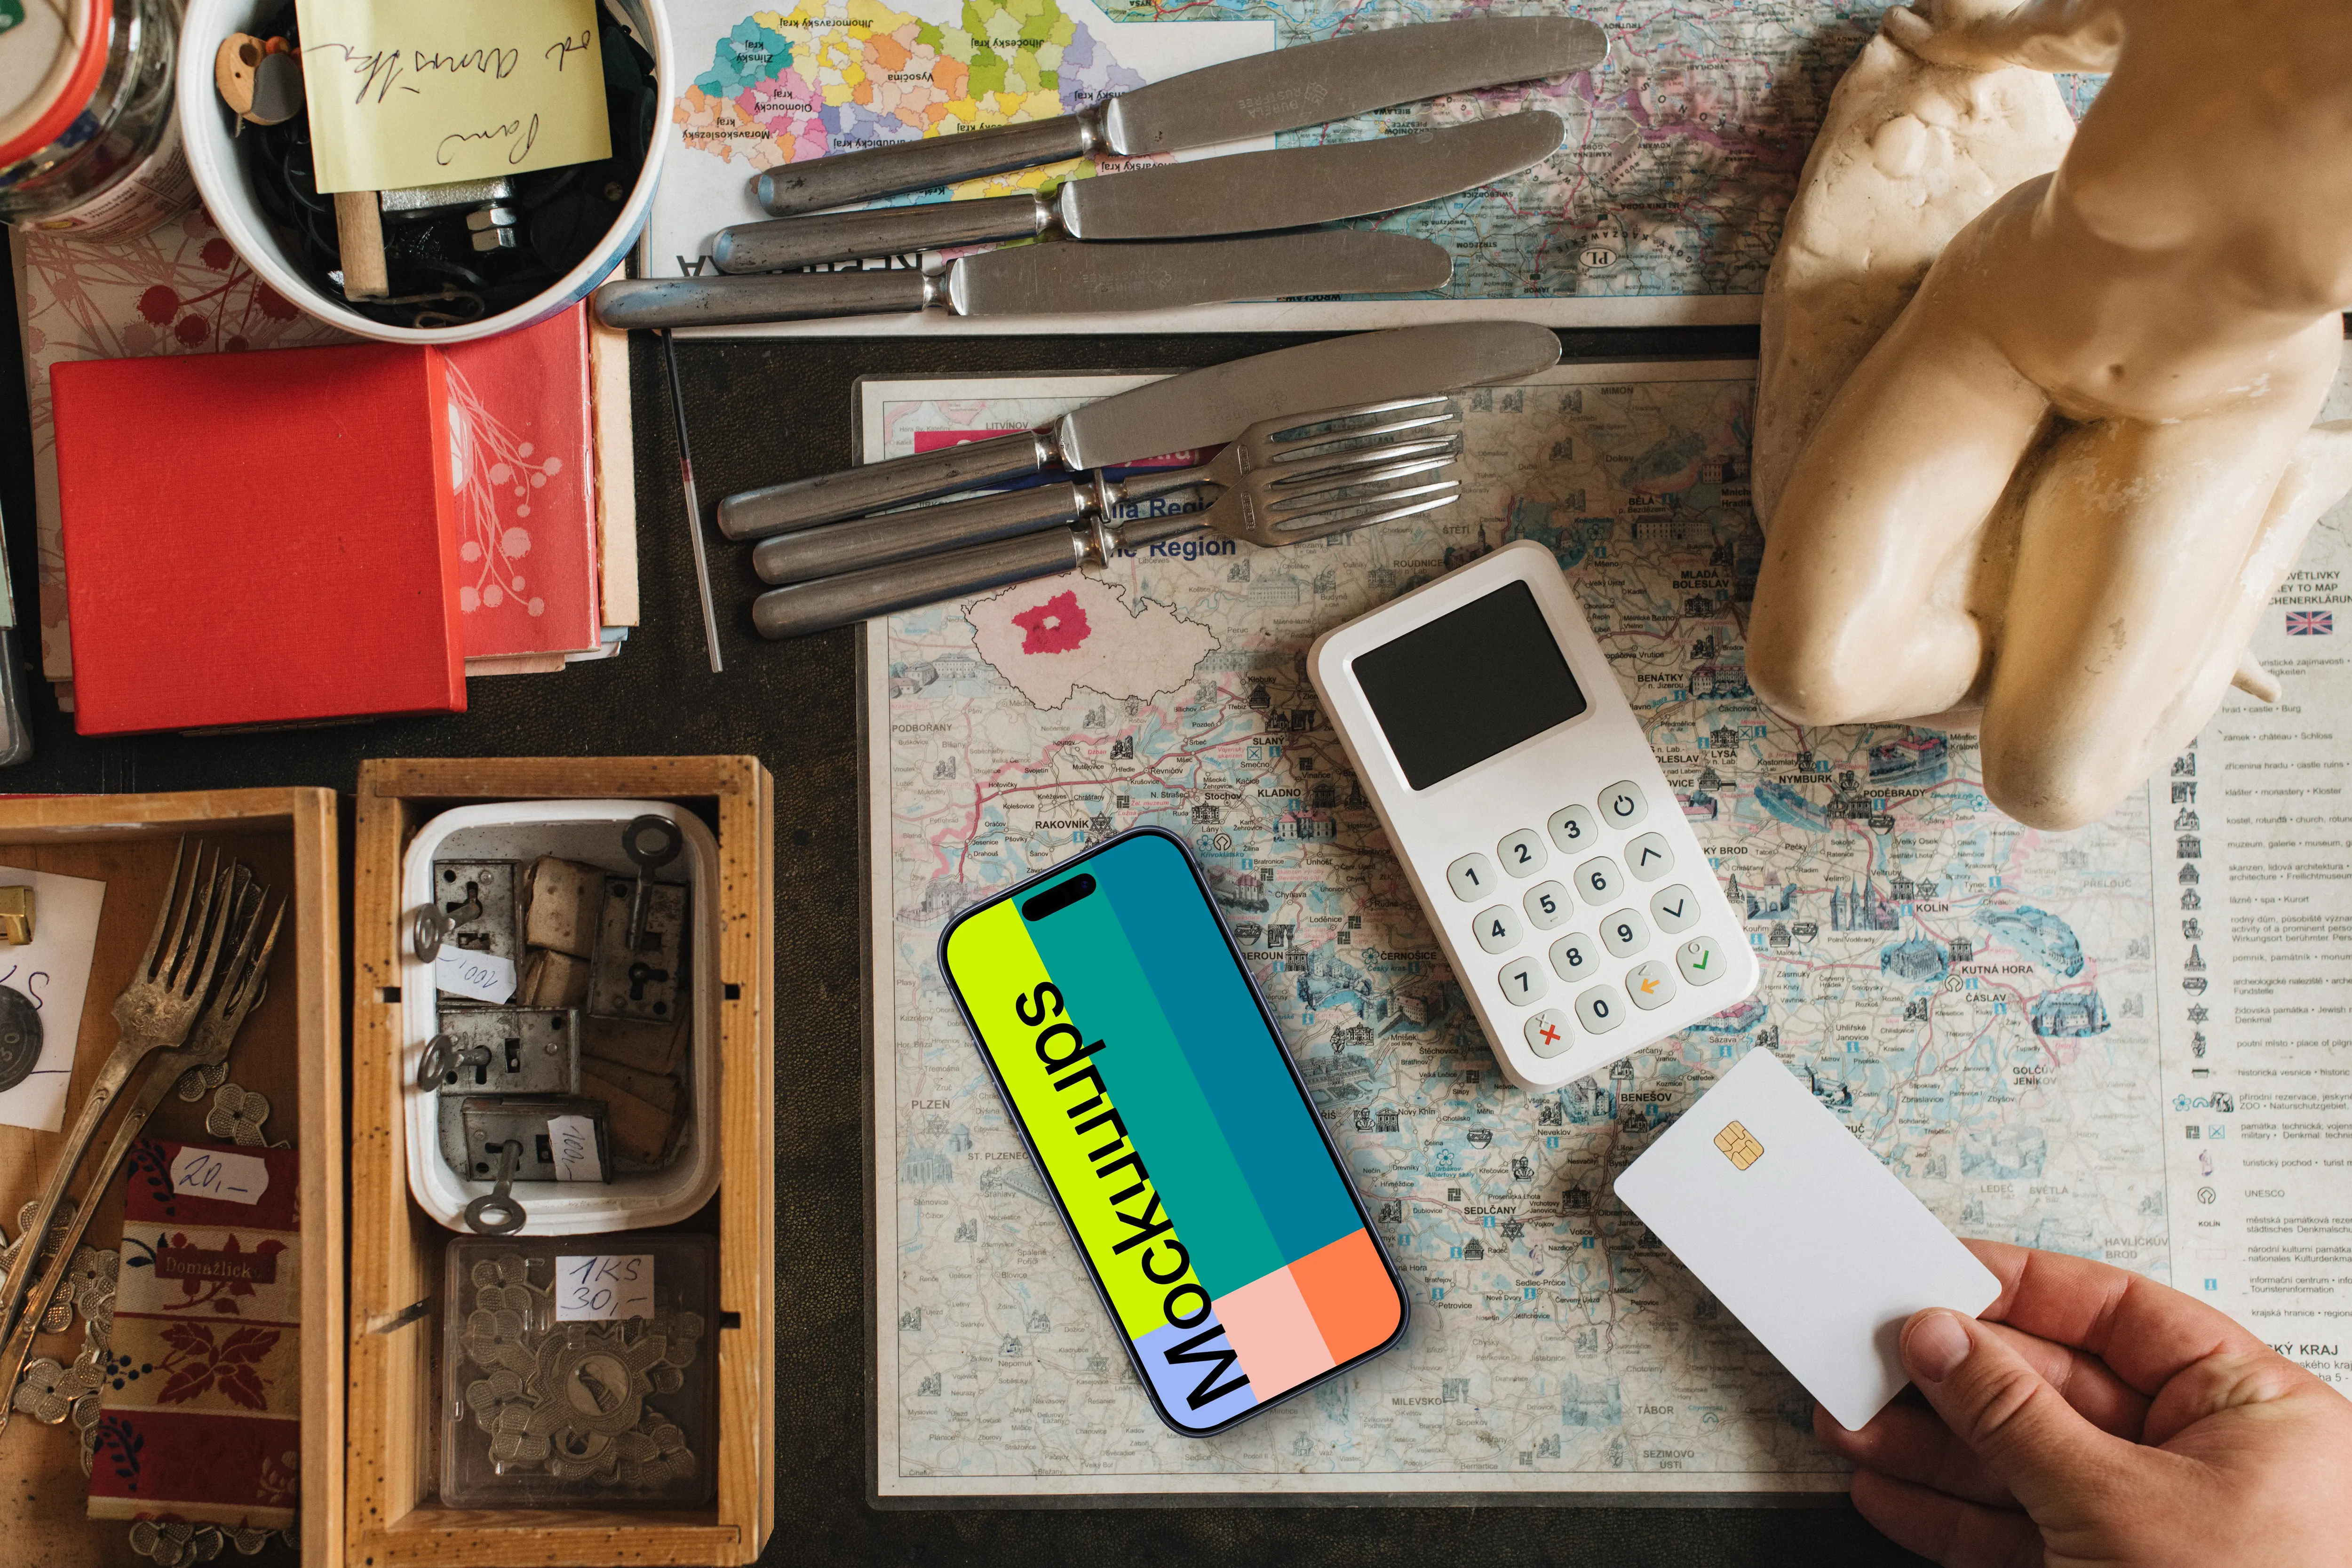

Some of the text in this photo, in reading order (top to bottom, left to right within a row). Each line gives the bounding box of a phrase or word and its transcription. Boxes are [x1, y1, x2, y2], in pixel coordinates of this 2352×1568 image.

[780, 18, 873, 29] Jihomoravský kraj
[745, 40, 764, 51] kraj
[971, 38, 1044, 49] Jihočeský kraj
[736, 53, 773, 64] Zlínský
[888, 72, 933, 83] Vysočina
[774, 89, 792, 100] kraj
[755, 102, 811, 113] Olomoucký
[716, 117, 735, 127] kraj
[683, 129, 770, 140] Moravskoslezský
[1587, 252, 1608, 264] PL
[986, 422, 1028, 430] LITVÍNOV
[1605, 454, 1634, 464] Doksy
[1629, 496, 1654, 505] BĚLÁ
[1443, 525, 1470, 534] ŠTĚTÍ
[1150, 539, 1236, 558] Region
[1681, 569, 1718, 580] MLADÁ
[1673, 579, 1729, 589] BOLESLAV
[2298, 583, 2338, 592] TO MAP
[1637, 674, 1684, 683] BENÁTKY
[2281, 705, 2301, 714] Burg
[893, 724, 952, 732] PODBOŘANY
[1253, 737, 1284, 746] SLANÝ
[1711, 748, 1737, 757] LYSÁ
[1151, 766, 1183, 775] Řevničov
[1779, 774, 1832, 784] NYMBURK
[1258, 789, 1301, 797] KLADNO
[1864, 788, 1925, 797] PODĚBRADY
[2261, 788, 2304, 797] monastery
[1035, 819, 1089, 829] RAKOVNÍK
[1564, 820, 1580, 839] 3
[1896, 837, 1917, 846] Velký
[1514, 844, 1532, 864] 2
[1465, 868, 1479, 886] 1
[1591, 872, 1606, 891] 6
[2083, 878, 2132, 888] PŘELOUČ
[1540, 894, 1556, 914] 5
[1916, 903, 1949, 913] KOLÍN
[1492, 919, 1506, 938] 4
[1617, 924, 1633, 942] 9
[1381, 951, 1437, 961] ČERNOŠICE
[1566, 947, 1582, 966] 8
[1962, 965, 2033, 974] KUTNÁ HORA
[1514, 972, 1529, 992] 7
[1965, 992, 2006, 1003] ČÁSLAV
[1593, 1000, 1609, 1019] 0
[2013, 1065, 2055, 1075] GOLČŮV
[2013, 1076, 2057, 1086] JENÍKOV
[1621, 1092, 1672, 1102] BENEŠOV
[912, 1098, 950, 1109] PLZEŇ
[968, 1152, 1028, 1161] ST. PLZENEC
[1981, 1185, 2014, 1194] LEDEČ
[2030, 1185, 2068, 1195] SVĚTLÁ
[1464, 1205, 1517, 1215] SEDLČANY
[2105, 1236, 2168, 1247] HAVLÍČKŮV
[2106, 1250, 2137, 1259] BROD
[1515, 1279, 1566, 1288] Sedlec-Prčice
[2251, 1285, 2334, 1293] Touristeninformation
[2301, 1345, 2338, 1355] KRAJ
[1391, 1397, 1442, 1406] MILEVSKO
[1637, 1405, 1674, 1415] TÁBOR
[1643, 1450, 1694, 1459] SEZIMOVO
[1660, 1459, 1682, 1470] ÚSTÍ
